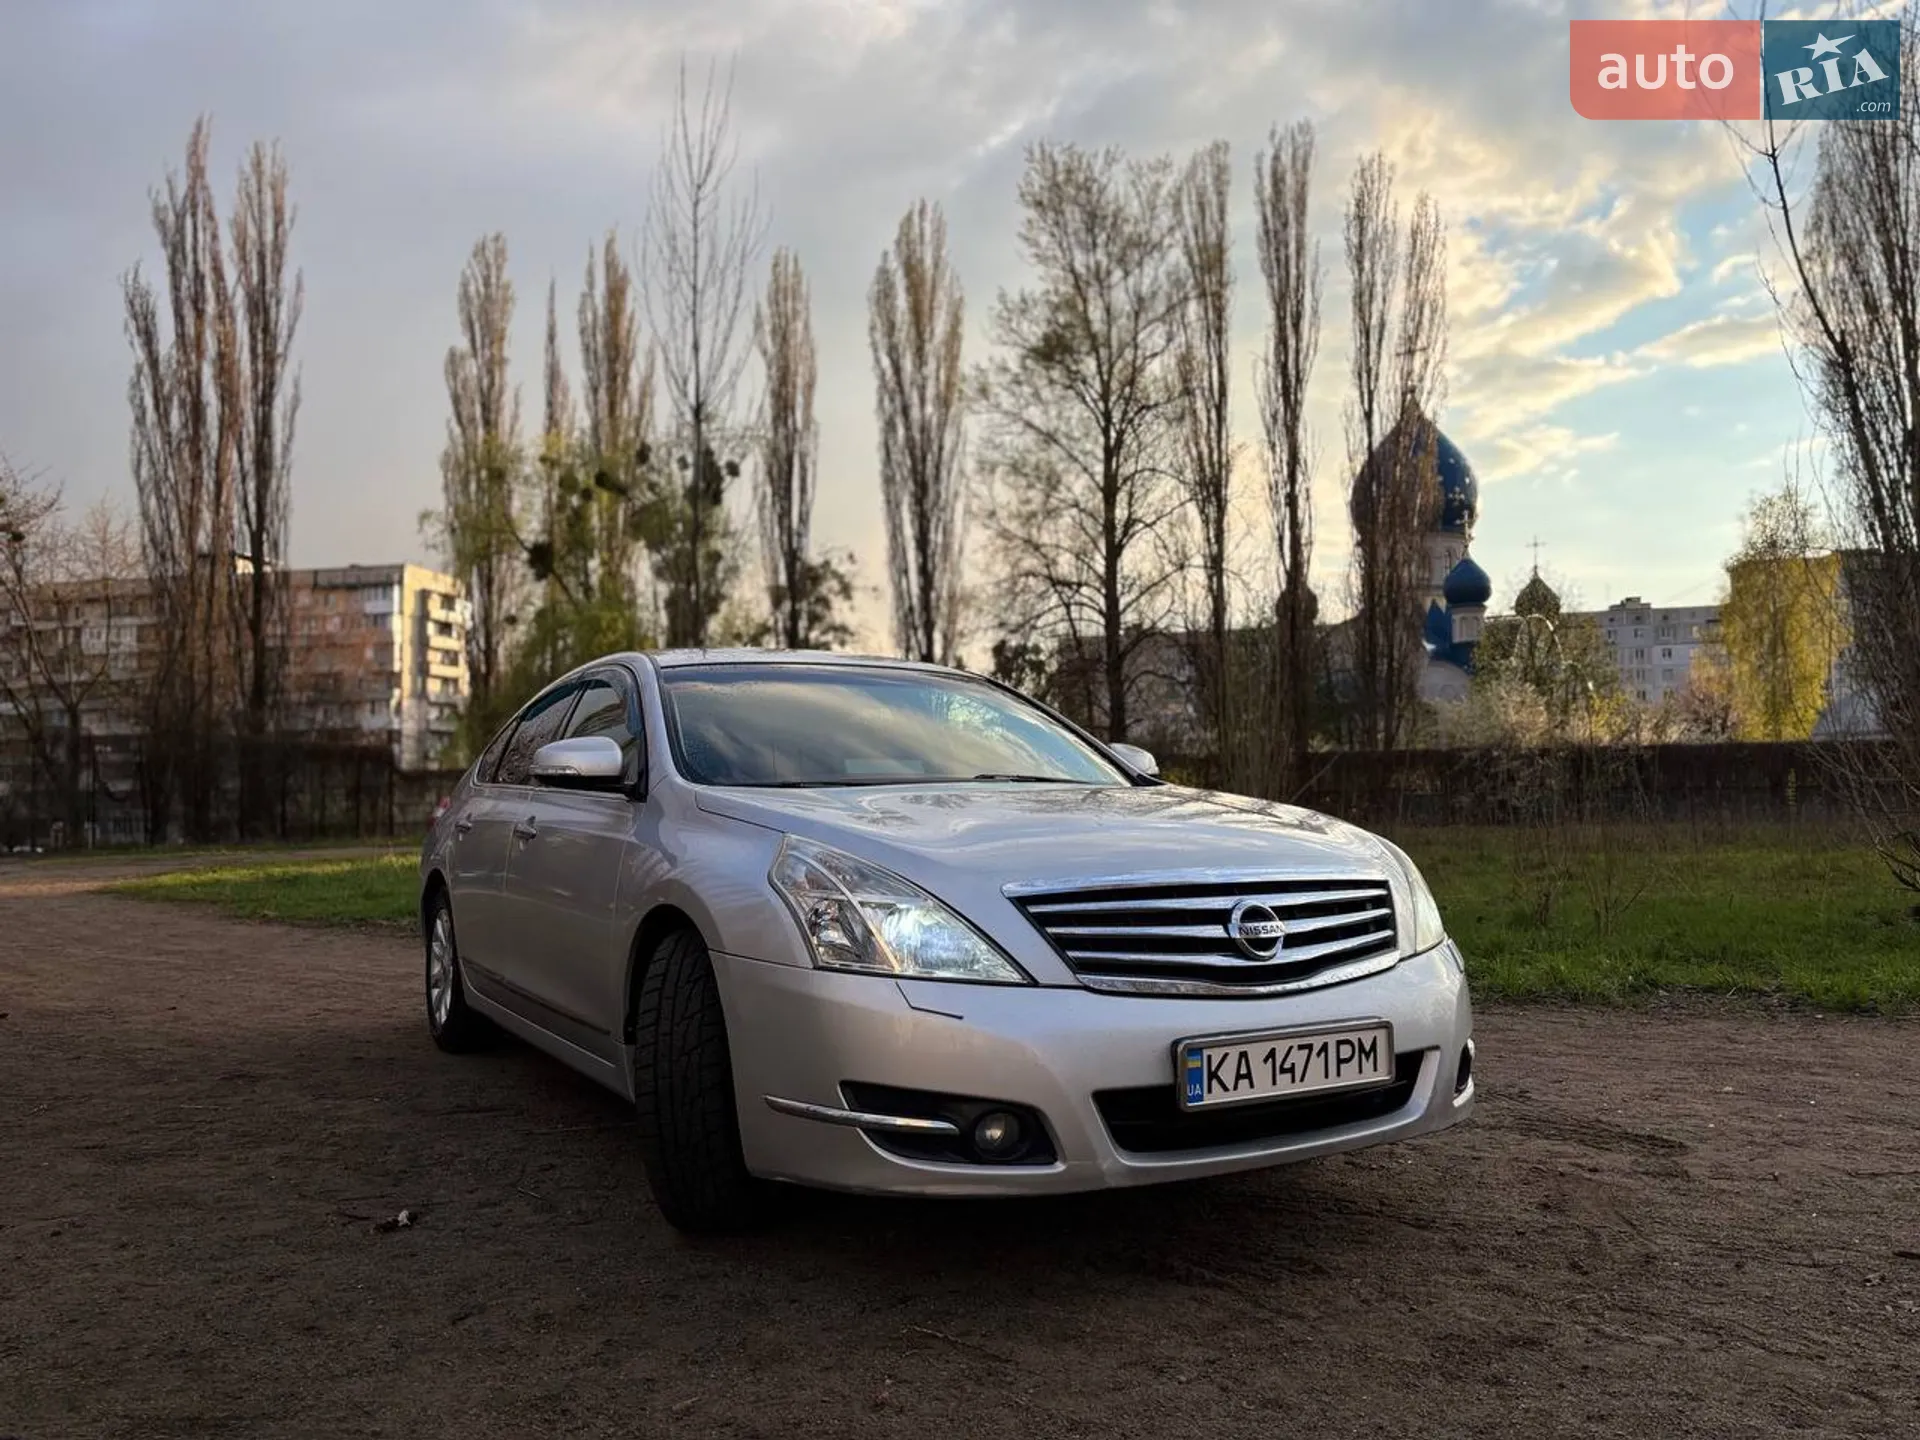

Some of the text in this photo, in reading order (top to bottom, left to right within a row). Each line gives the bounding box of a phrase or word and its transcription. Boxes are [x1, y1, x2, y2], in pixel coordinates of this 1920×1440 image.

[1239, 924, 1282, 936] NISSAN
[1207, 1050, 1255, 1094] KA
[1187, 1084, 1202, 1097] UA
